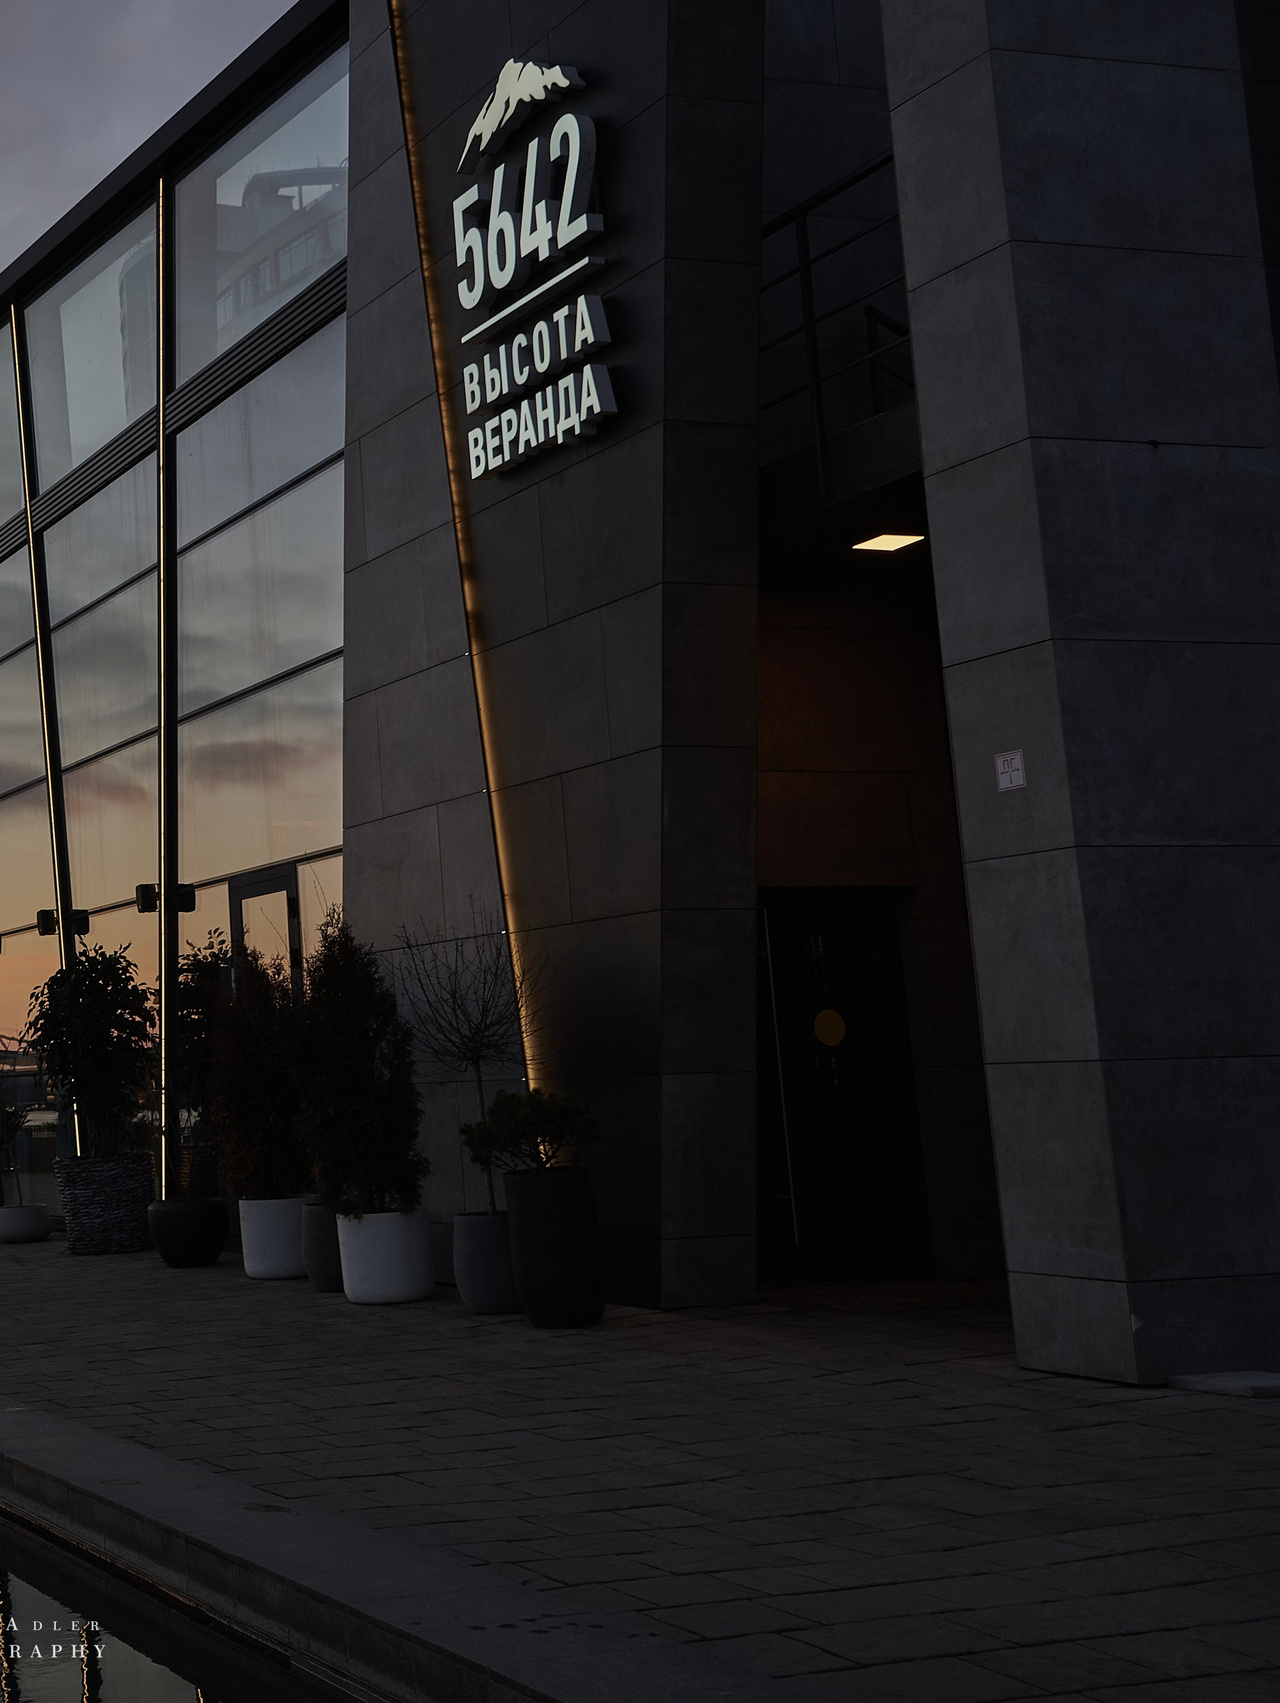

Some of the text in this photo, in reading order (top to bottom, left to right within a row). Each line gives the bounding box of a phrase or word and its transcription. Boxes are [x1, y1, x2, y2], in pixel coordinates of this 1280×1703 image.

[452, 113, 588, 310] 5642
[463, 293, 595, 416] ВЫСОТА
[467, 363, 601, 480] ВЕРАНДА
